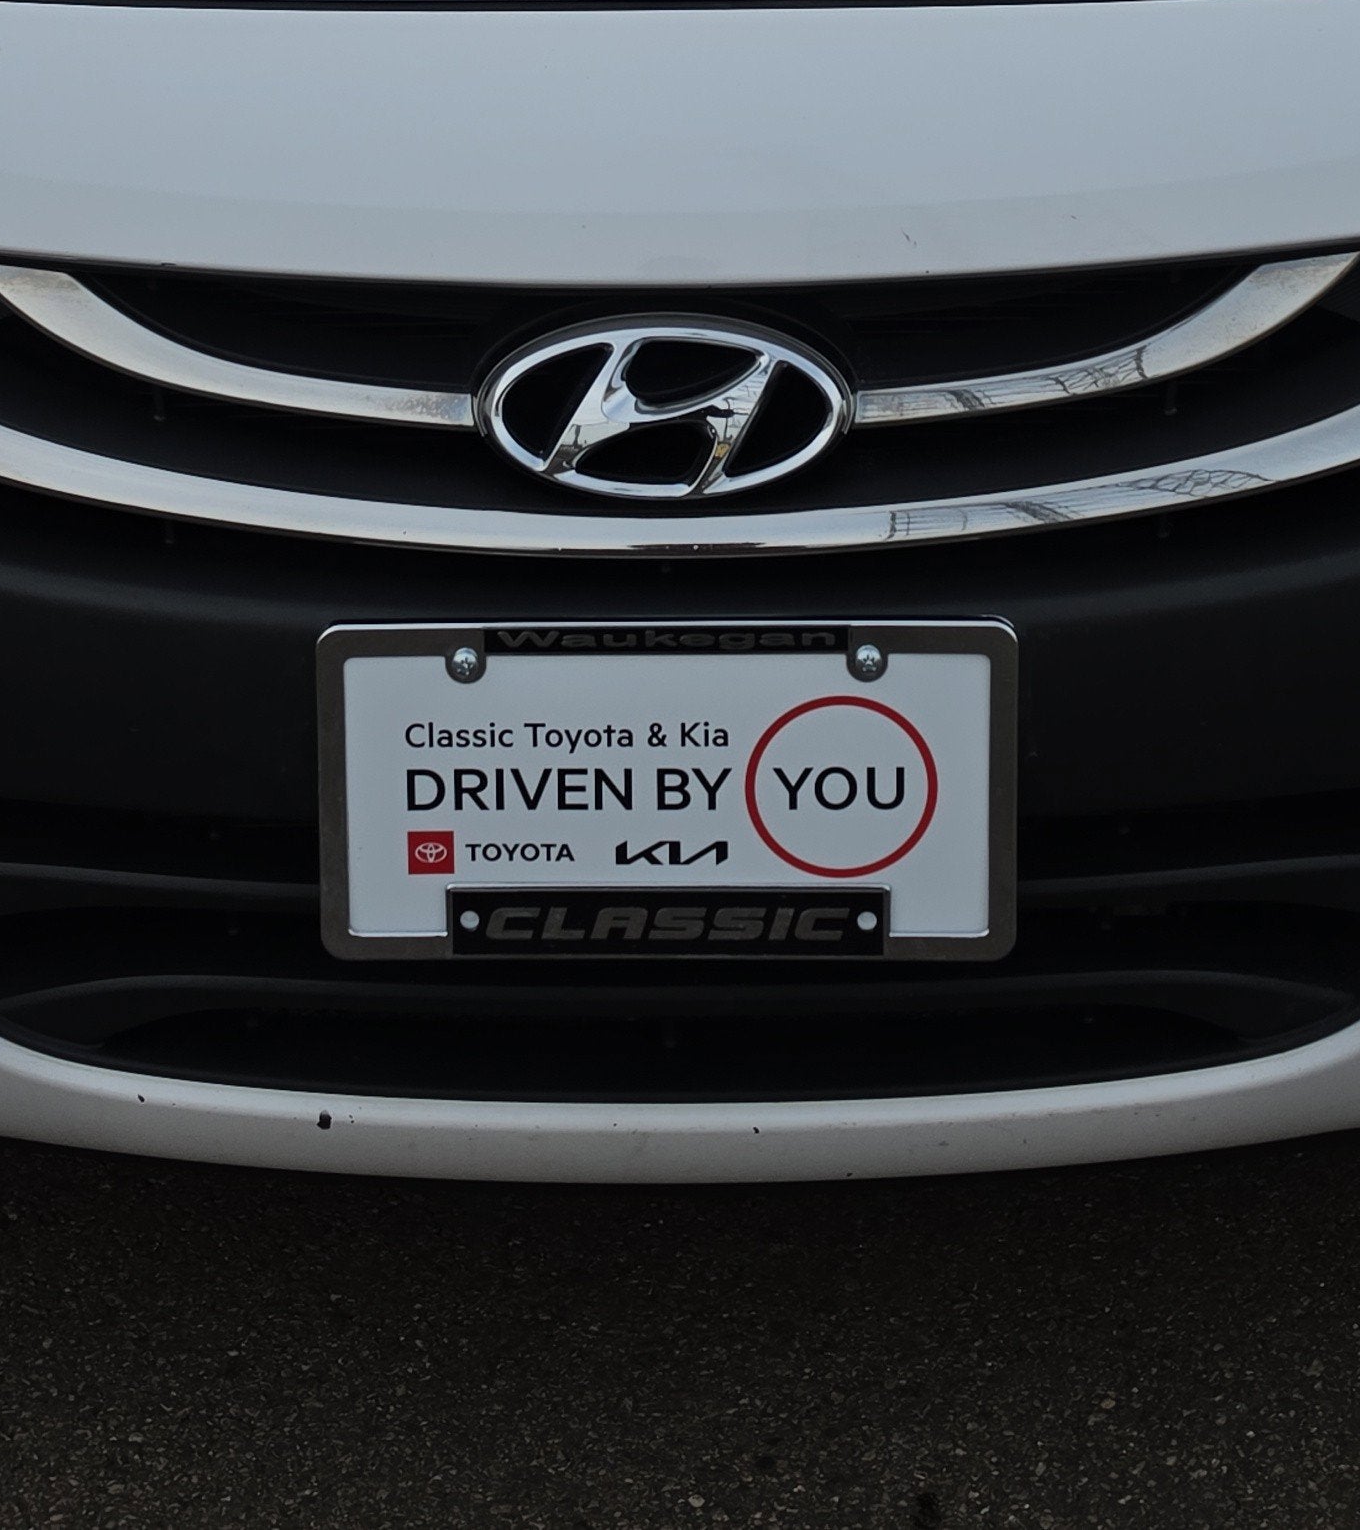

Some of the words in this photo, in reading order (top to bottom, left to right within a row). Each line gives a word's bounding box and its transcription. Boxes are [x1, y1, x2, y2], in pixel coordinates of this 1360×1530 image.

[497, 629, 836, 651] Waukegan
[404, 721, 514, 749] Classic
[523, 721, 634, 755] Toyota
[647, 722, 668, 749] &
[679, 721, 730, 749] Kia
[405, 767, 633, 812] DRIVEN
[655, 767, 733, 812] BY
[771, 766, 906, 812] YOU
[464, 842, 575, 863] TOYOTA
[485, 906, 851, 941] CLASSIC
